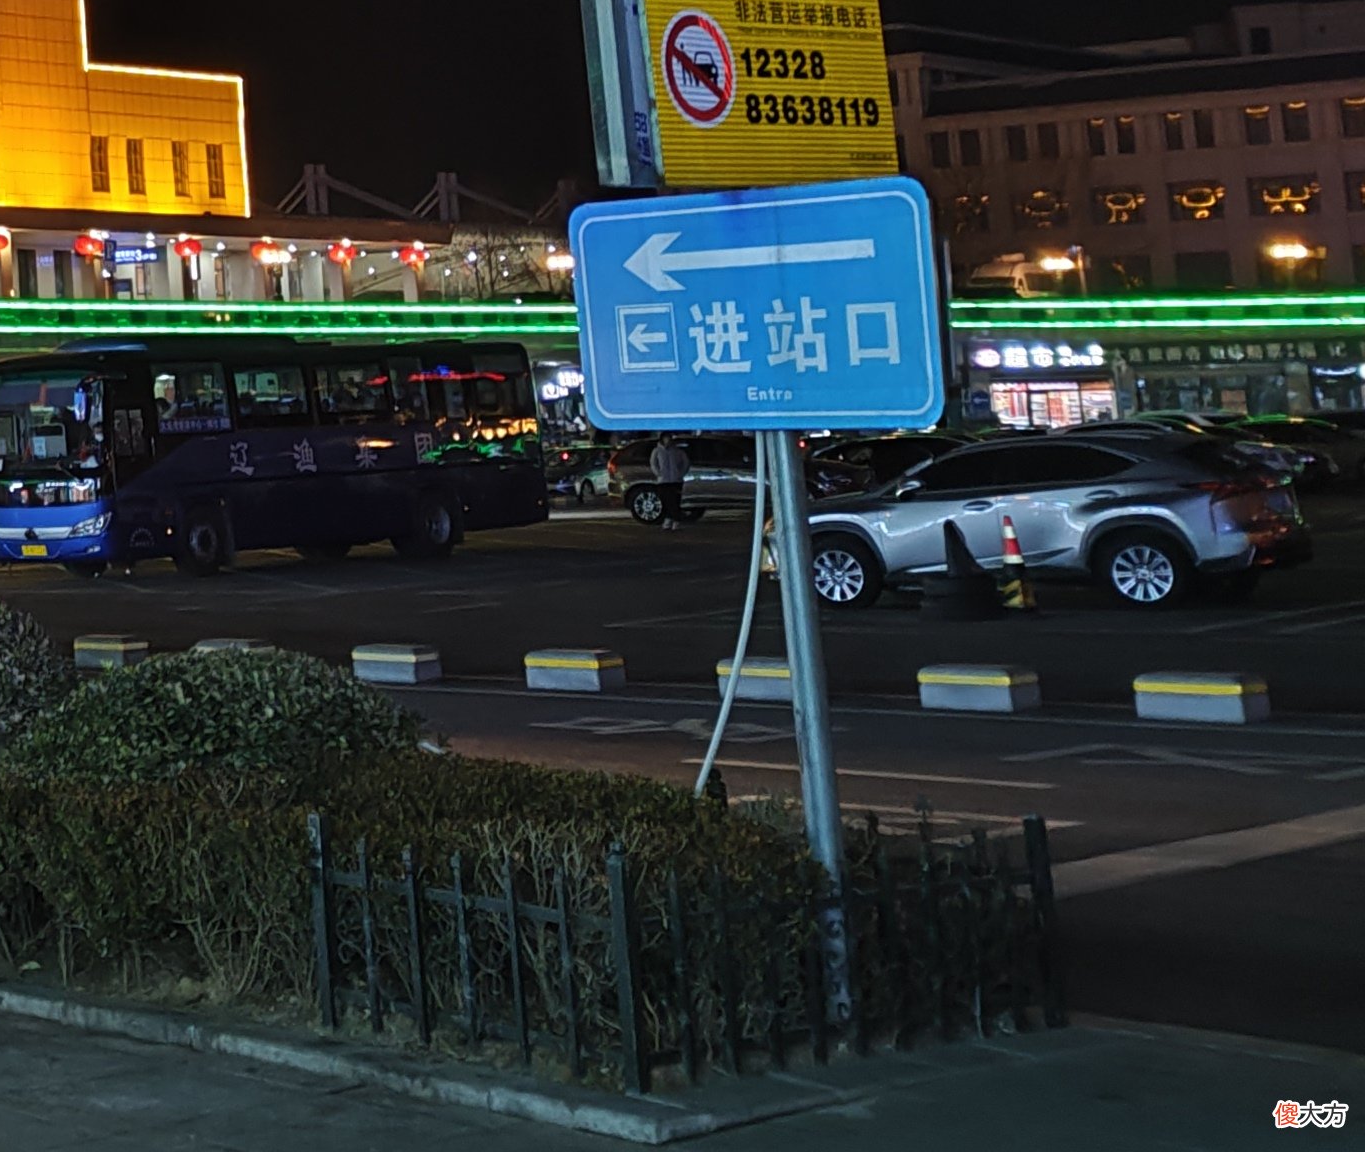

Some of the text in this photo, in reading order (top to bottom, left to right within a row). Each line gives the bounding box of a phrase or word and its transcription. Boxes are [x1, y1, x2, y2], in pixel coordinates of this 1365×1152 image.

[740, 48, 826, 80] 12328
[745, 94, 879, 126] 83638119
[689, 296, 901, 374] 进站口
